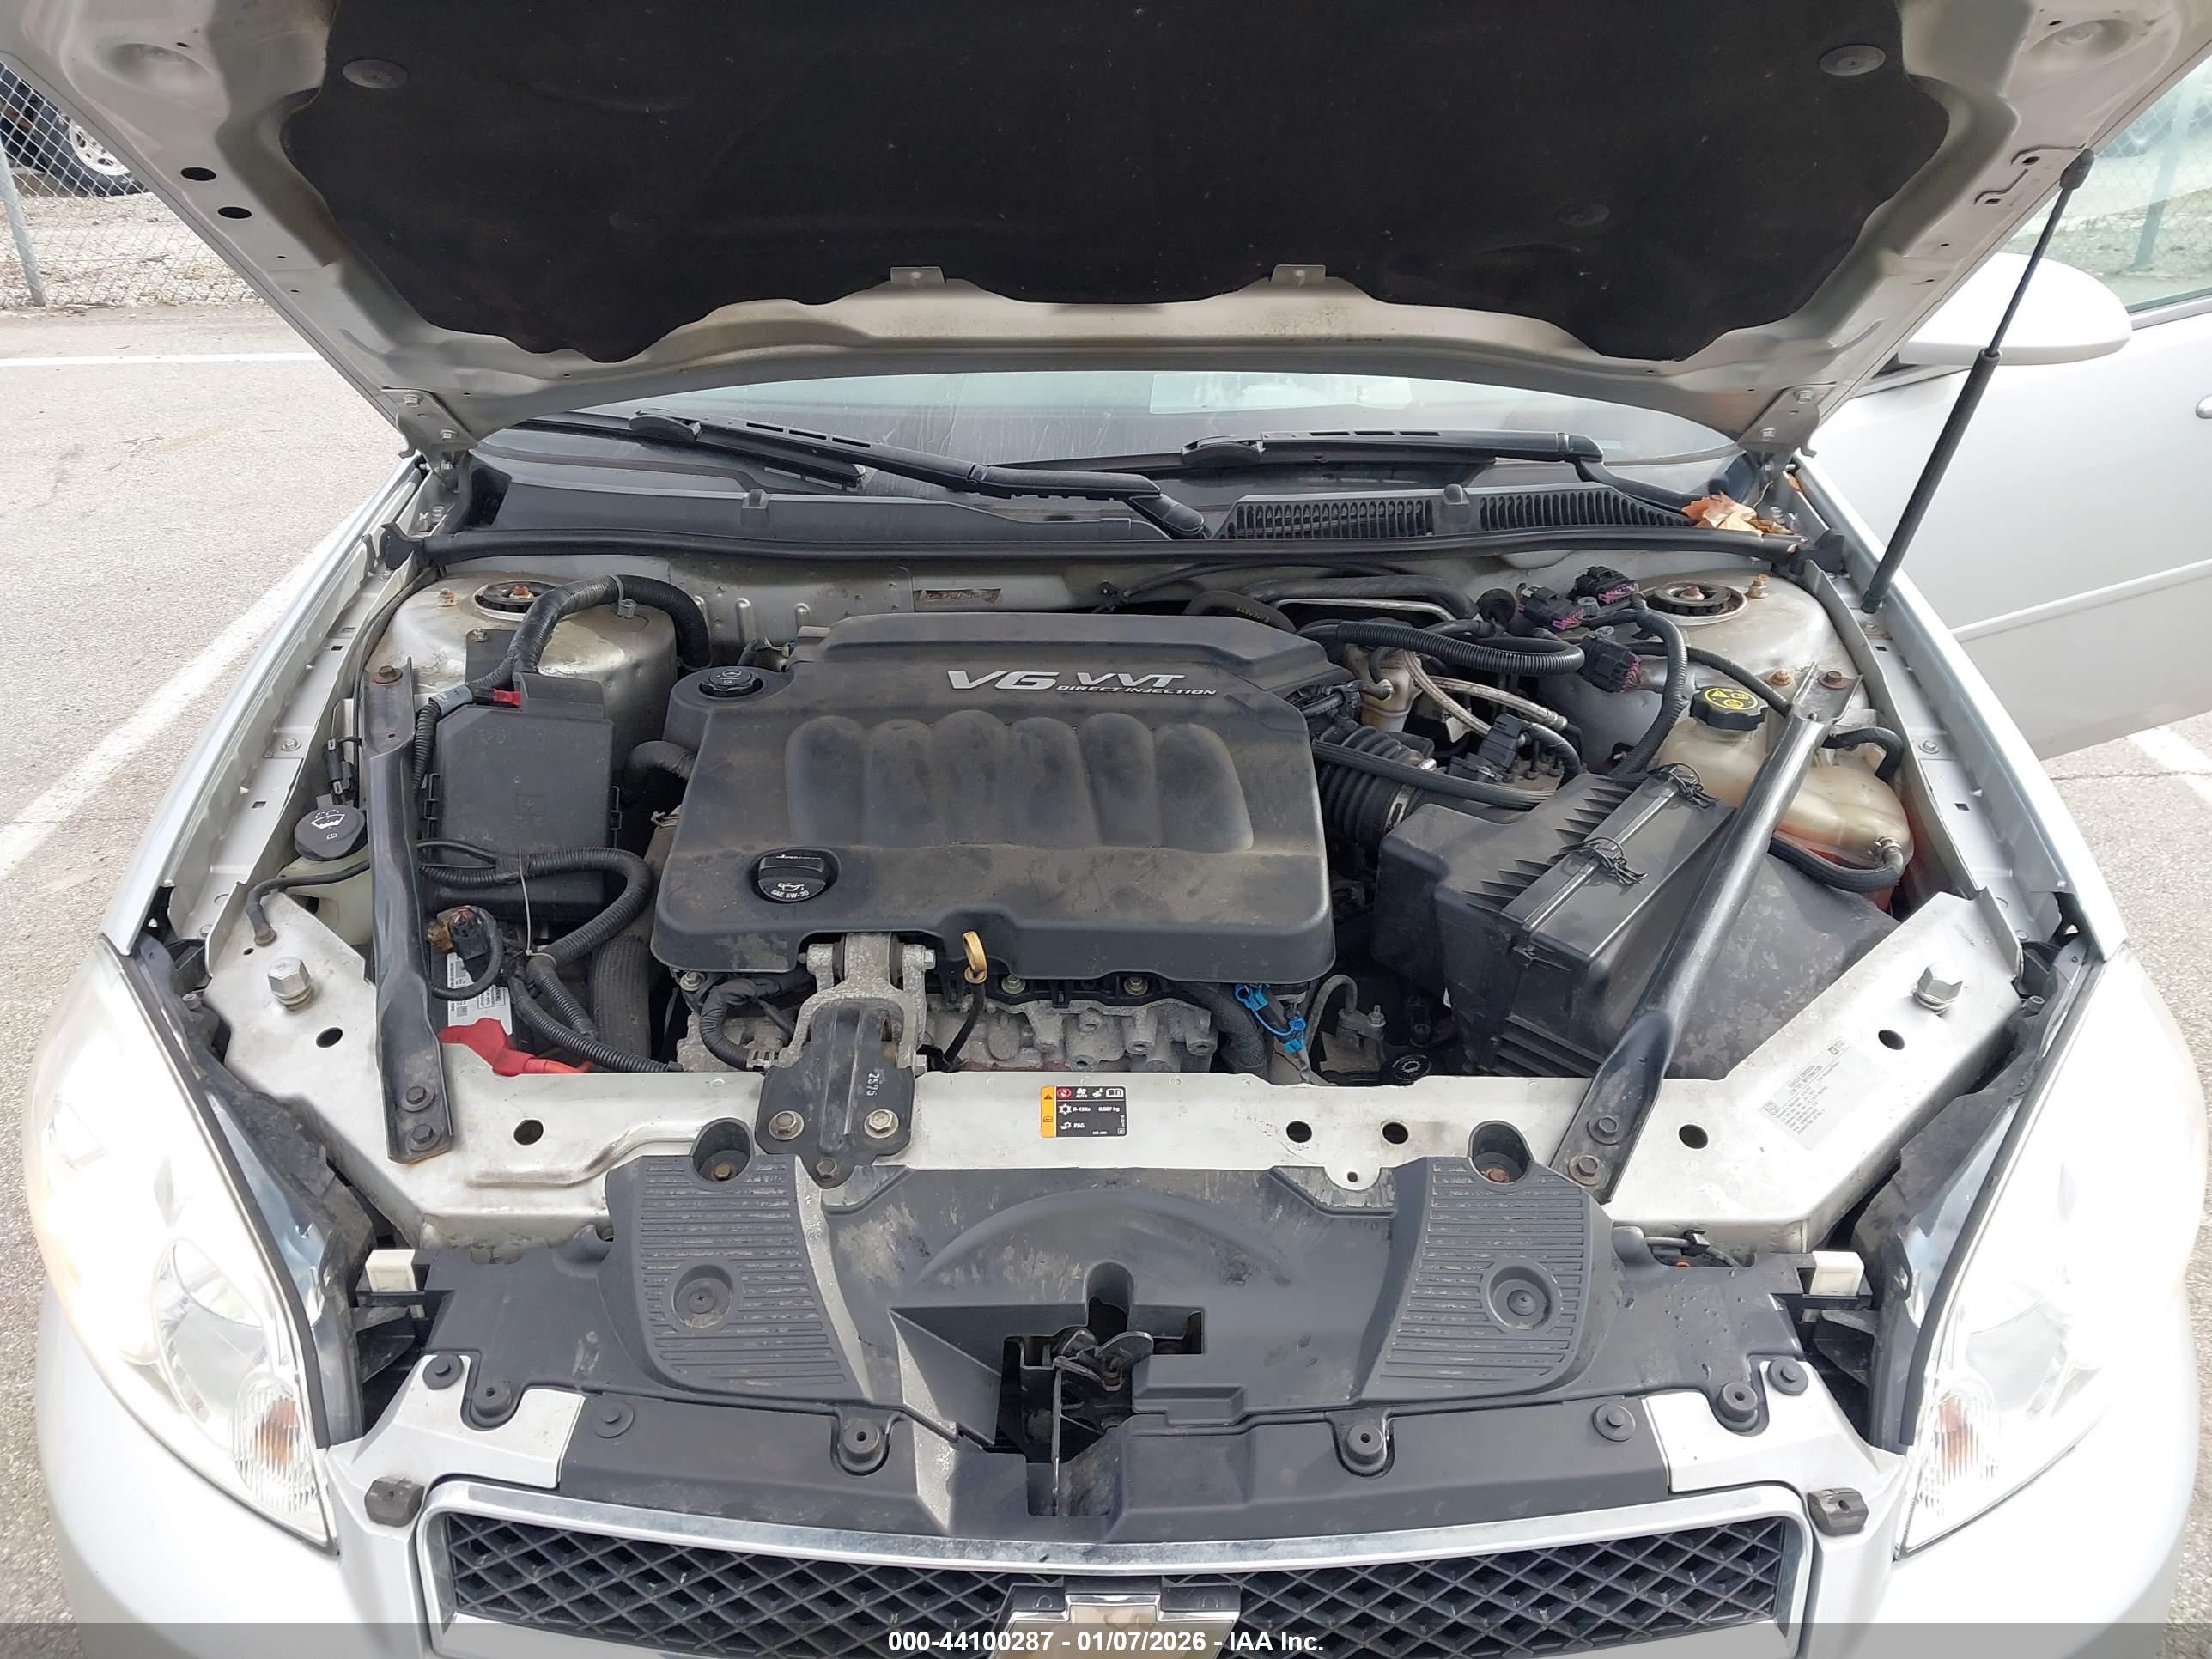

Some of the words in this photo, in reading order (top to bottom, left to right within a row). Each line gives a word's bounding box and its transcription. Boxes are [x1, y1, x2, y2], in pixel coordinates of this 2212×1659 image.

[947, 671, 1060, 690] V6
[1077, 672, 1186, 688] VVT
[866, 1073, 880, 1097] 2575
